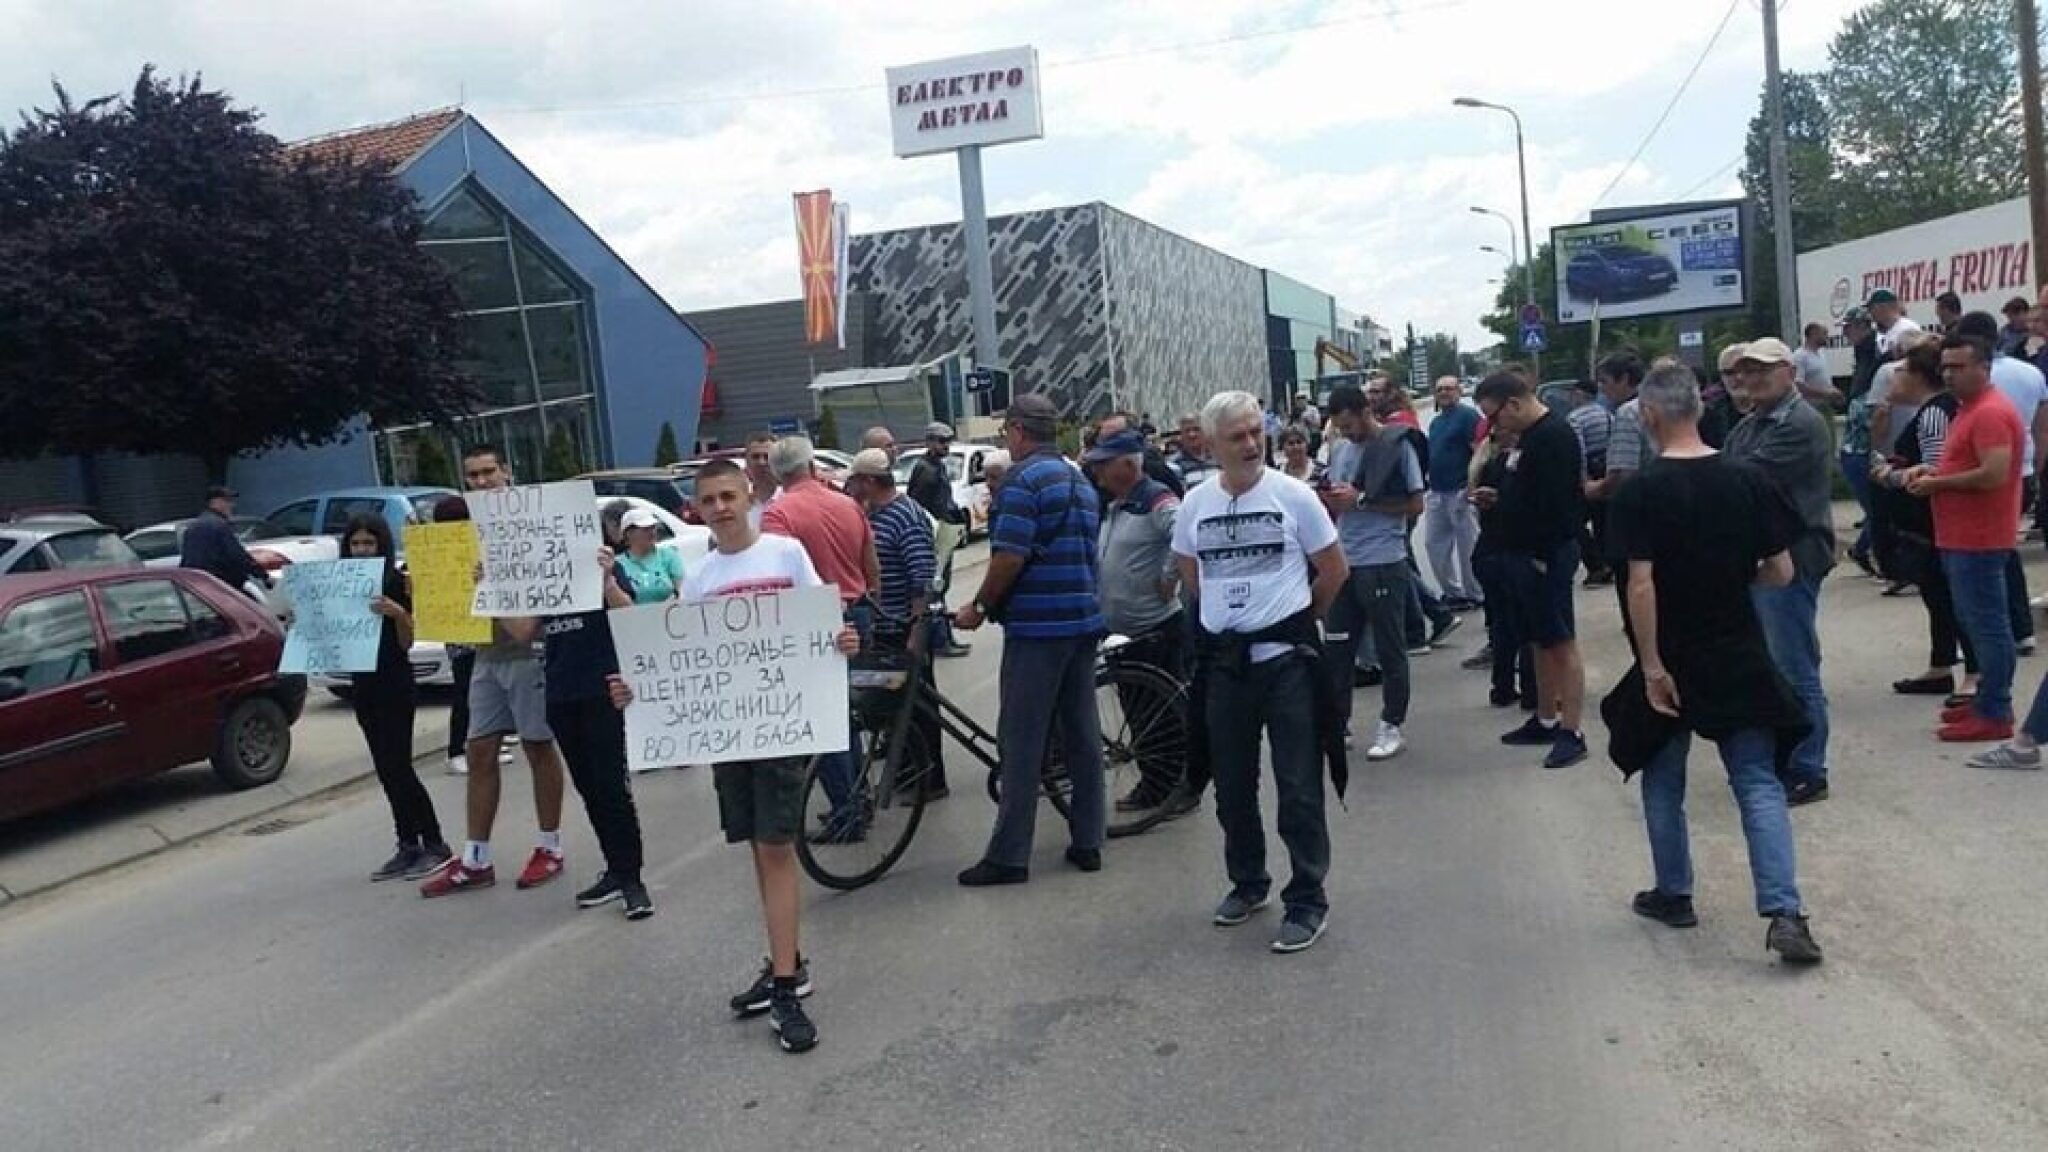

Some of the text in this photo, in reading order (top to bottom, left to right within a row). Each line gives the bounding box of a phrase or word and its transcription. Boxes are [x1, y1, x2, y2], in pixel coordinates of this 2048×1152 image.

[896, 67, 1024, 105] ЕЛЕКТРО
[917, 99, 1008, 131] МЕТАЛ
[573, 513, 596, 537] НА
[544, 539, 569, 562] ЗА
[526, 584, 573, 609] БАБА
[665, 592, 781, 640] СТОП
[633, 630, 837, 675] ЗА ОТВОРАЊЕ НА
[638, 666, 786, 703] ЦЕНТАР ЗА
[664, 691, 803, 727] ЗАВИСНИЦИ
[643, 719, 815, 762] ВО ГАЗИ БАБА
